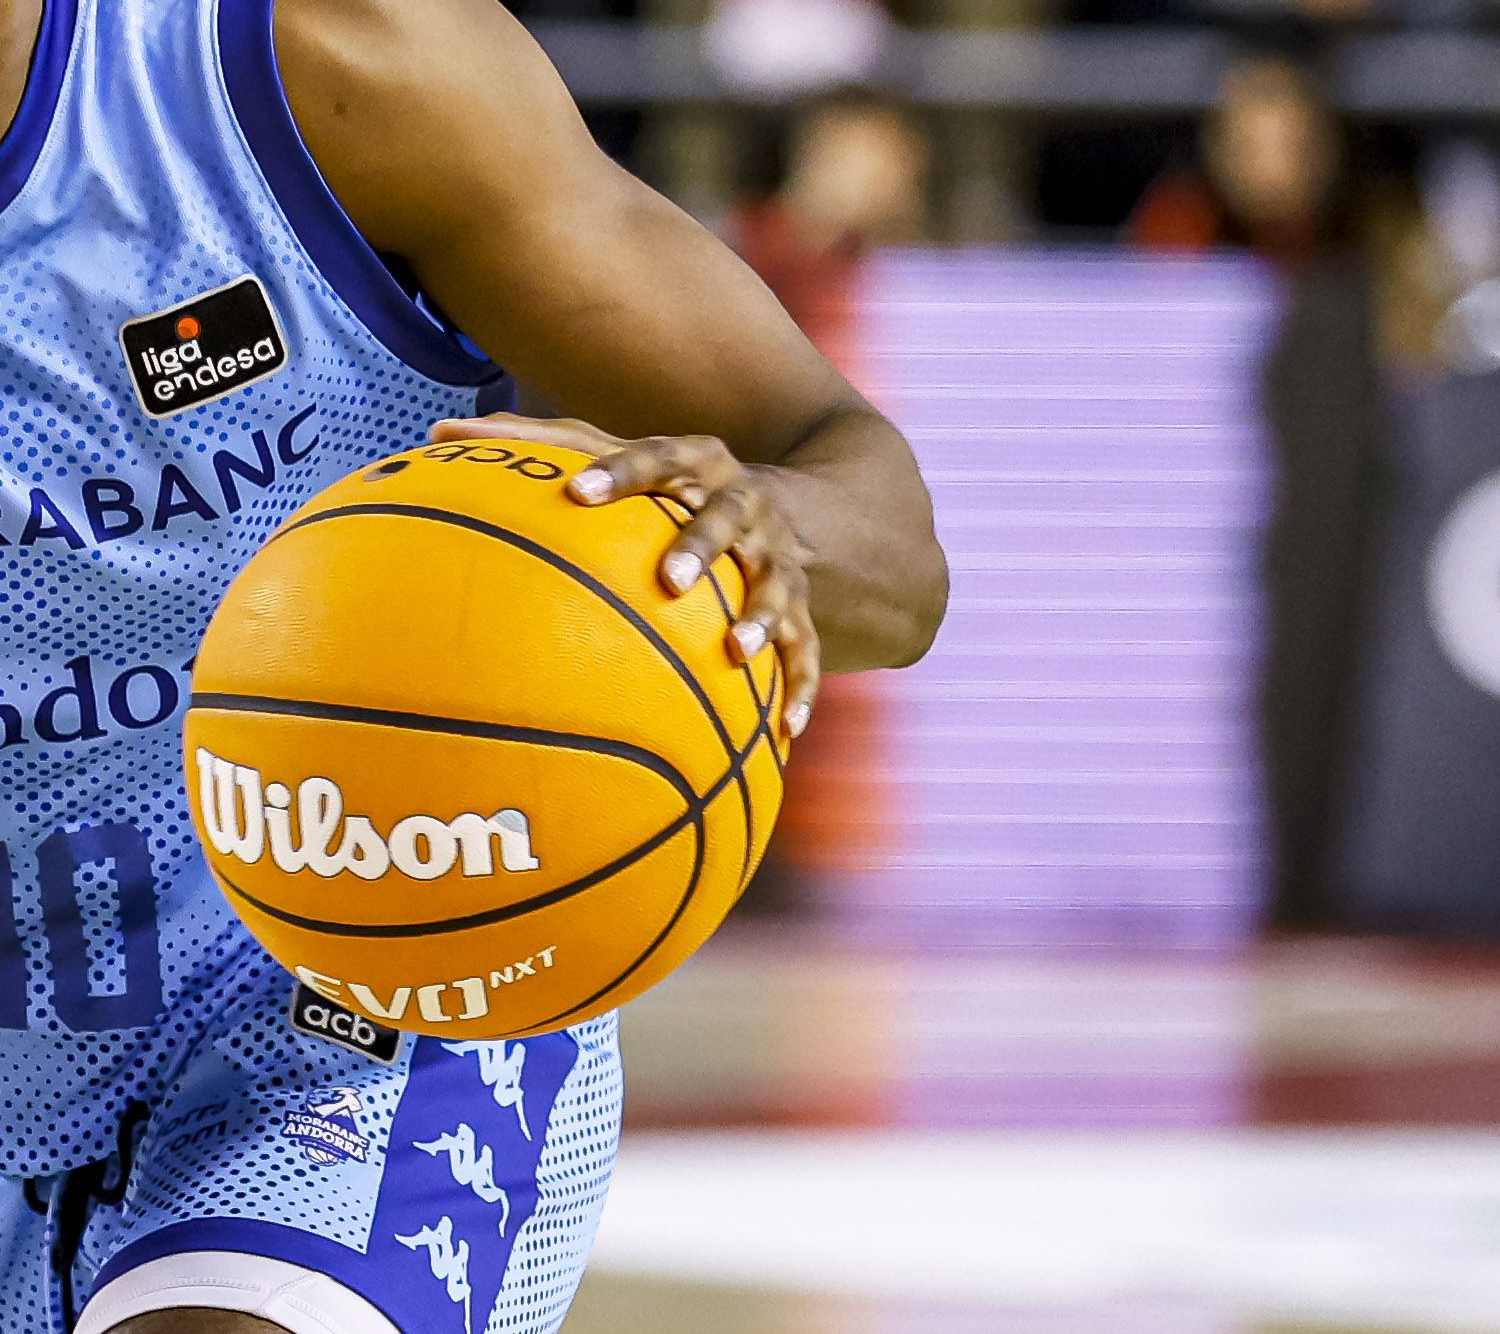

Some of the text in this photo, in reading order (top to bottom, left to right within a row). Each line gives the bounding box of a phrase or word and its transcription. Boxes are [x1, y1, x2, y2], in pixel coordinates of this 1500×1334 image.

[141, 339, 202, 375] liga
[153, 337, 276, 401] endesa
[195, 747, 542, 881] Wilson
[294, 945, 558, 1023] EVO NXT
[303, 1005, 377, 1046] acb
[283, 1123, 366, 1159] ANDORRA
[288, 1113, 369, 1148] MORABANC
